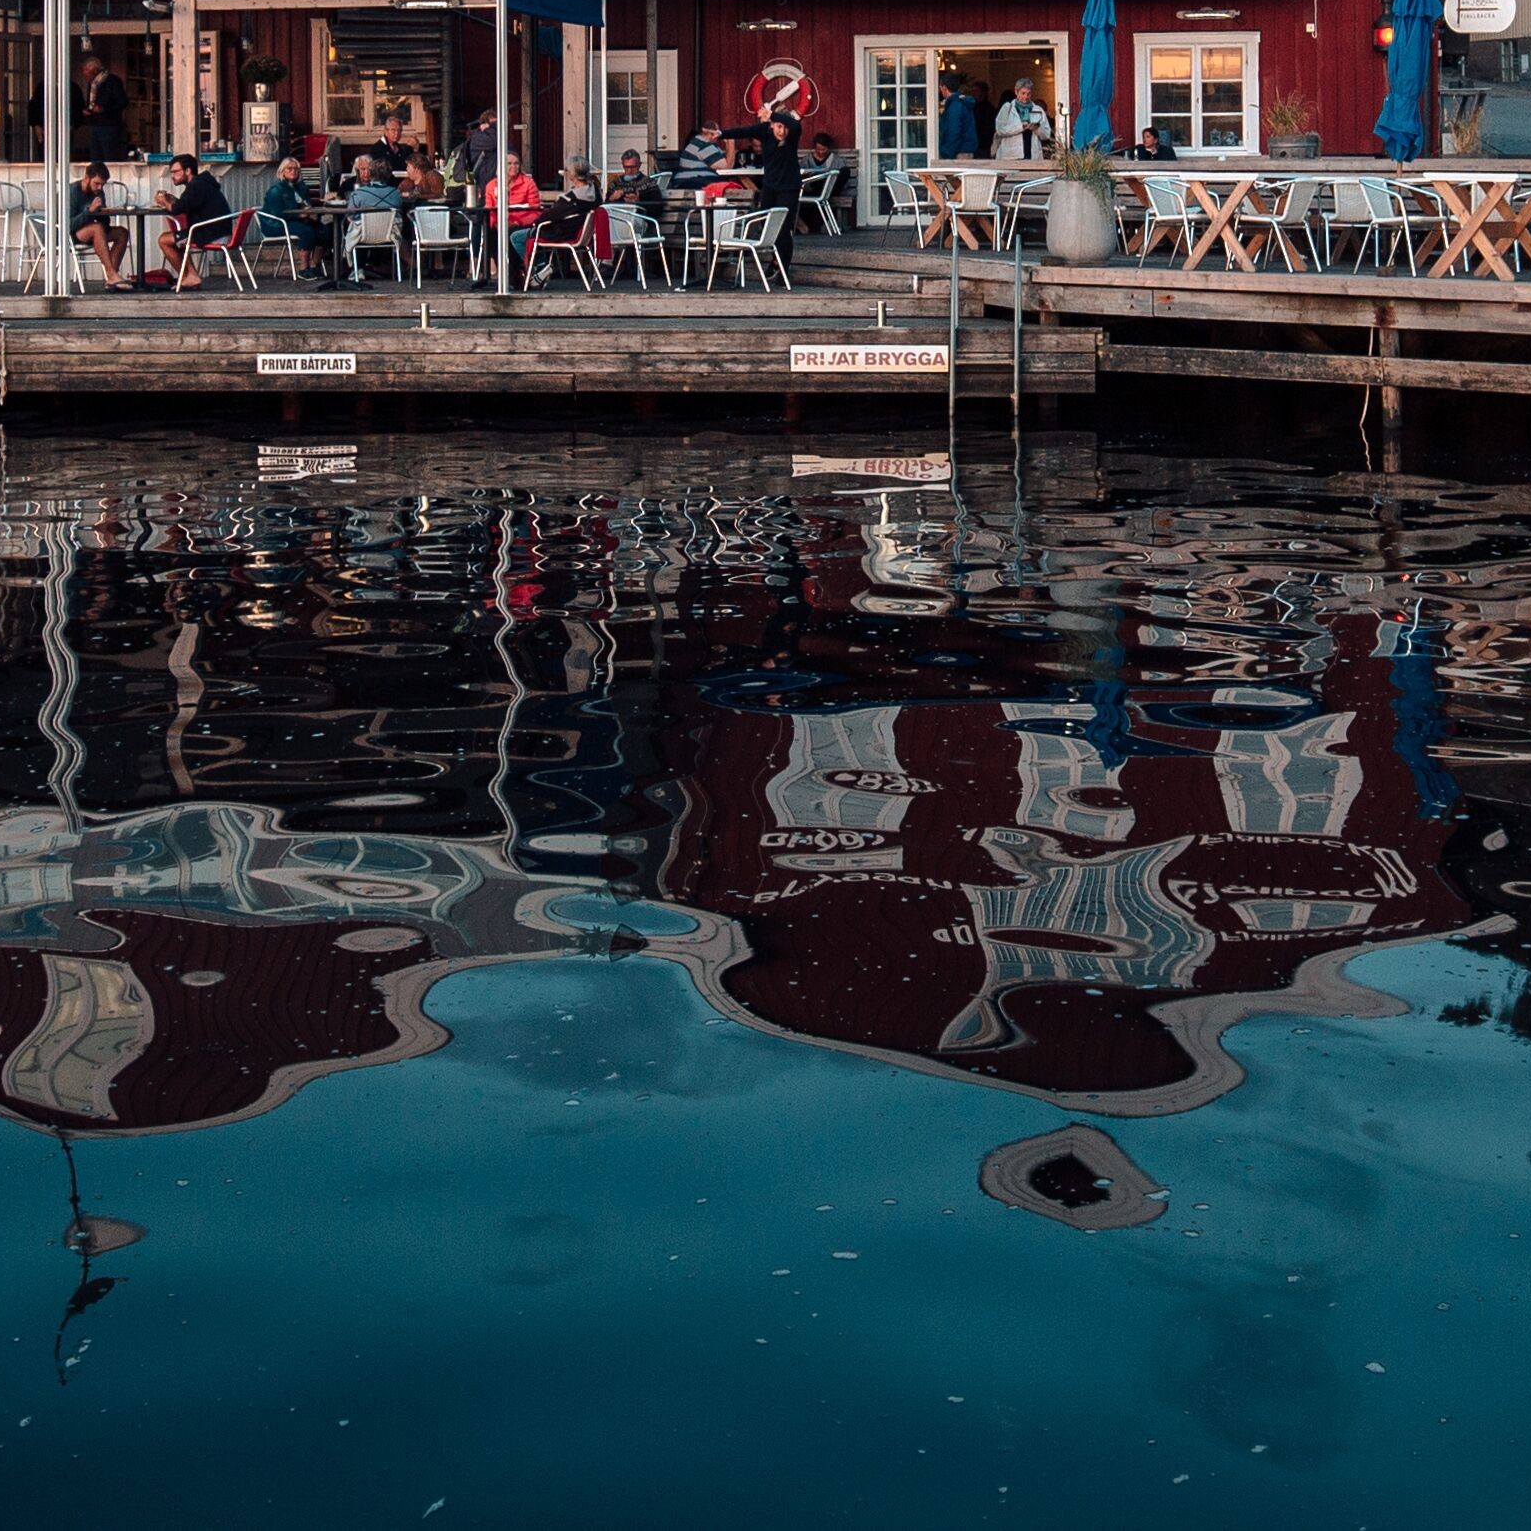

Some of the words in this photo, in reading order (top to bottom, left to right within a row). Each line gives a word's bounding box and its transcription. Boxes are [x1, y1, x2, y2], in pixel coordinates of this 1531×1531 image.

[261, 358, 298, 371] PRIVAT
[300, 355, 352, 371] BÅTPLATS
[864, 351, 946, 366] BRYGGA
